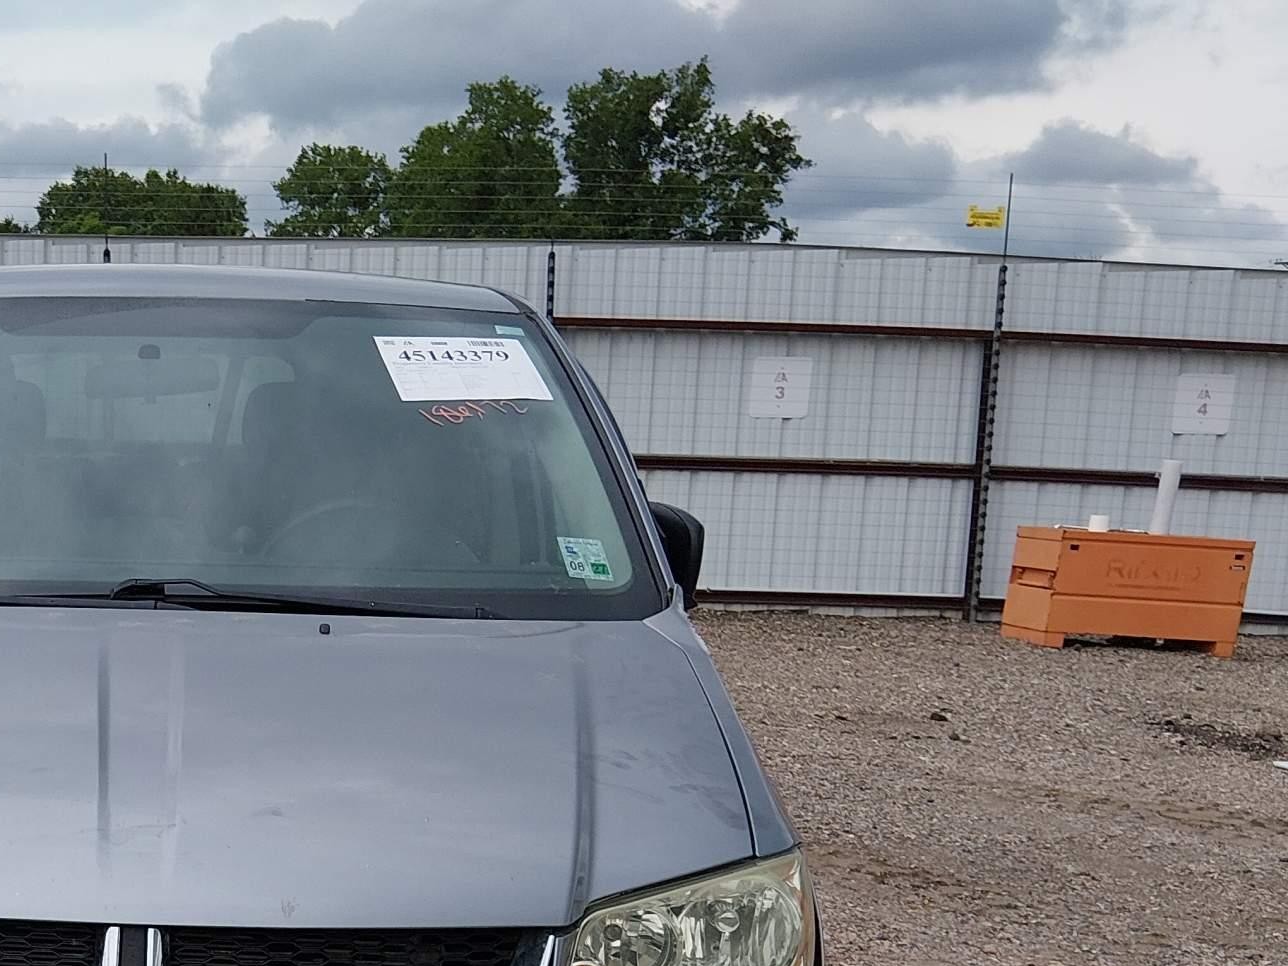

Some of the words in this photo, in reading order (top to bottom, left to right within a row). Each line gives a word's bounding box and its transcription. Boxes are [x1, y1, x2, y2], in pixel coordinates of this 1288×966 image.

[399, 350, 509, 362] 45143379
[775, 386, 785, 400] 3
[1196, 402, 1208, 417] 4
[569, 560, 586, 572] 08
[592, 563, 611, 576] 27
